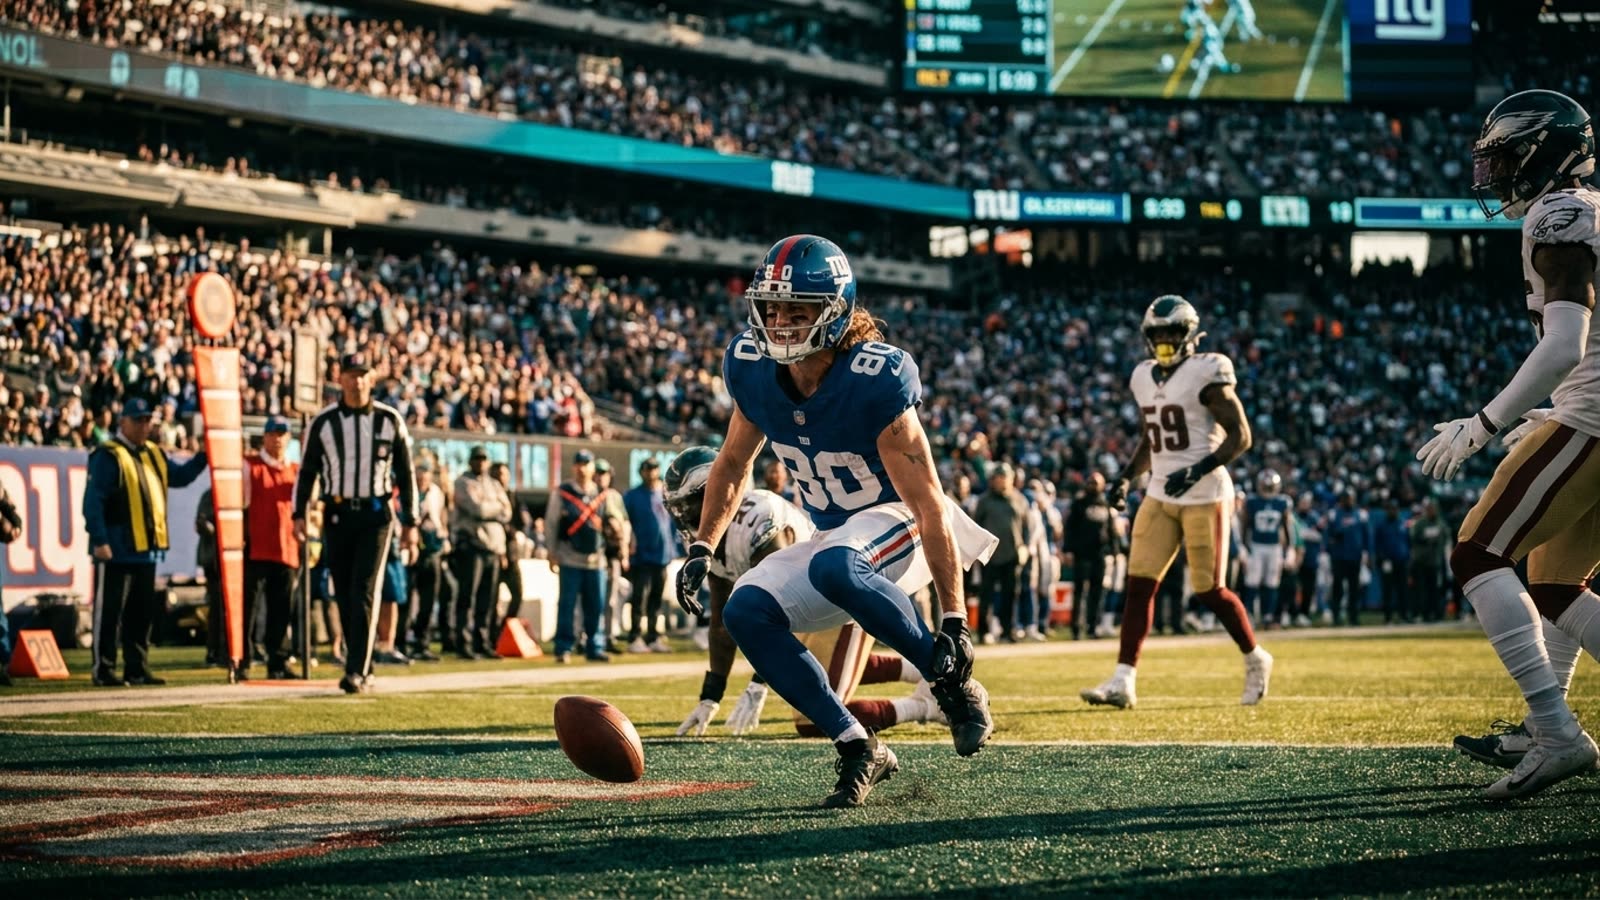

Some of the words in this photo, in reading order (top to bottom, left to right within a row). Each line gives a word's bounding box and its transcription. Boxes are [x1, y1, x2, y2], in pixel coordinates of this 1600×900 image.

[764, 264, 793, 281] 80
[850, 341, 903, 376] 80
[1142, 404, 1190, 453] 59
[771, 441, 883, 511] 80
[28, 636, 62, 672] 20
